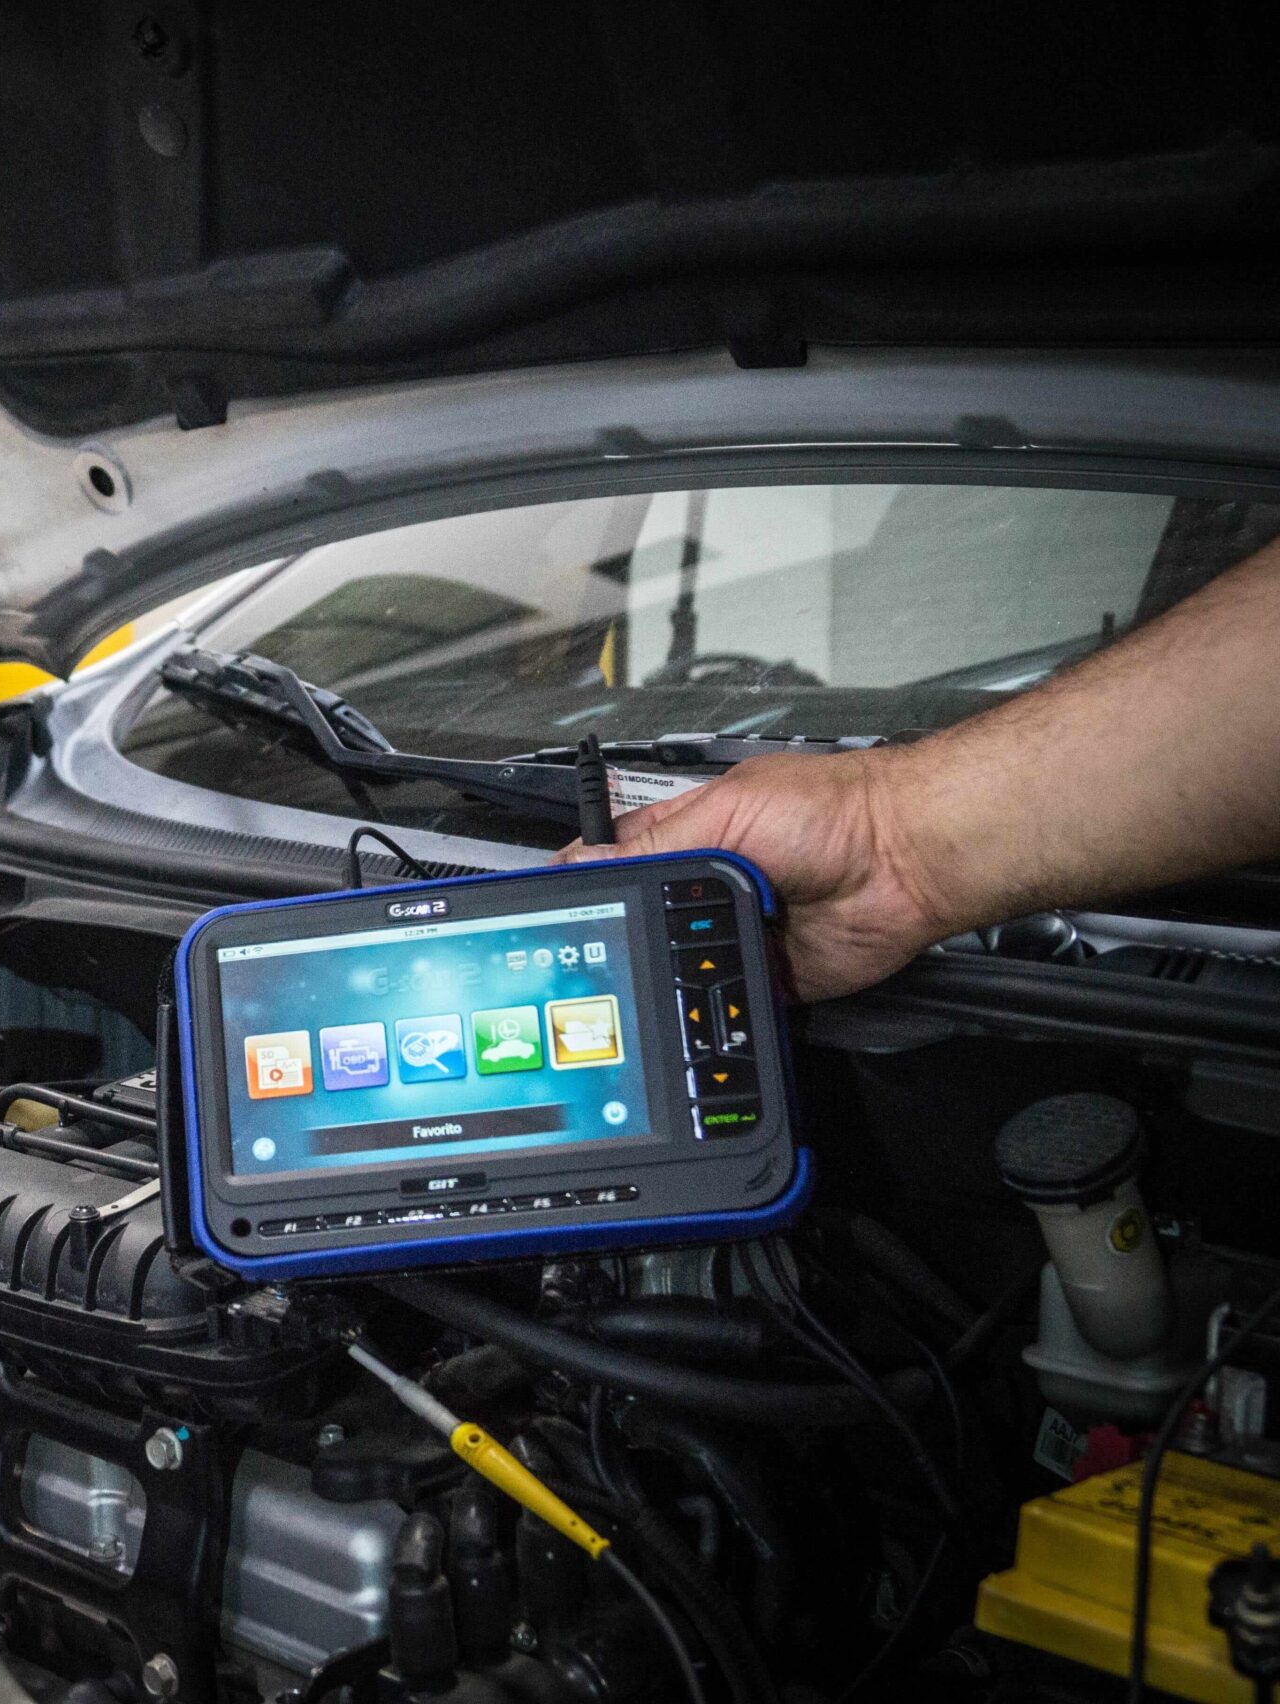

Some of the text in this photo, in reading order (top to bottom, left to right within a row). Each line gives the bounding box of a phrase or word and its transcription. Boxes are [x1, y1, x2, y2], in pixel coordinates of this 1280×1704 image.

[432, 901, 446, 913] 2
[689, 918, 714, 931] ESC
[342, 1055, 366, 1066] OBD
[703, 1112, 740, 1126] ENTER
[413, 1123, 463, 1139] Favorito
[597, 1190, 615, 1202] F6
[470, 1203, 488, 1214] F4
[533, 1198, 551, 1209] F5
[345, 1215, 363, 1226] F2
[283, 1222, 297, 1233] F1
